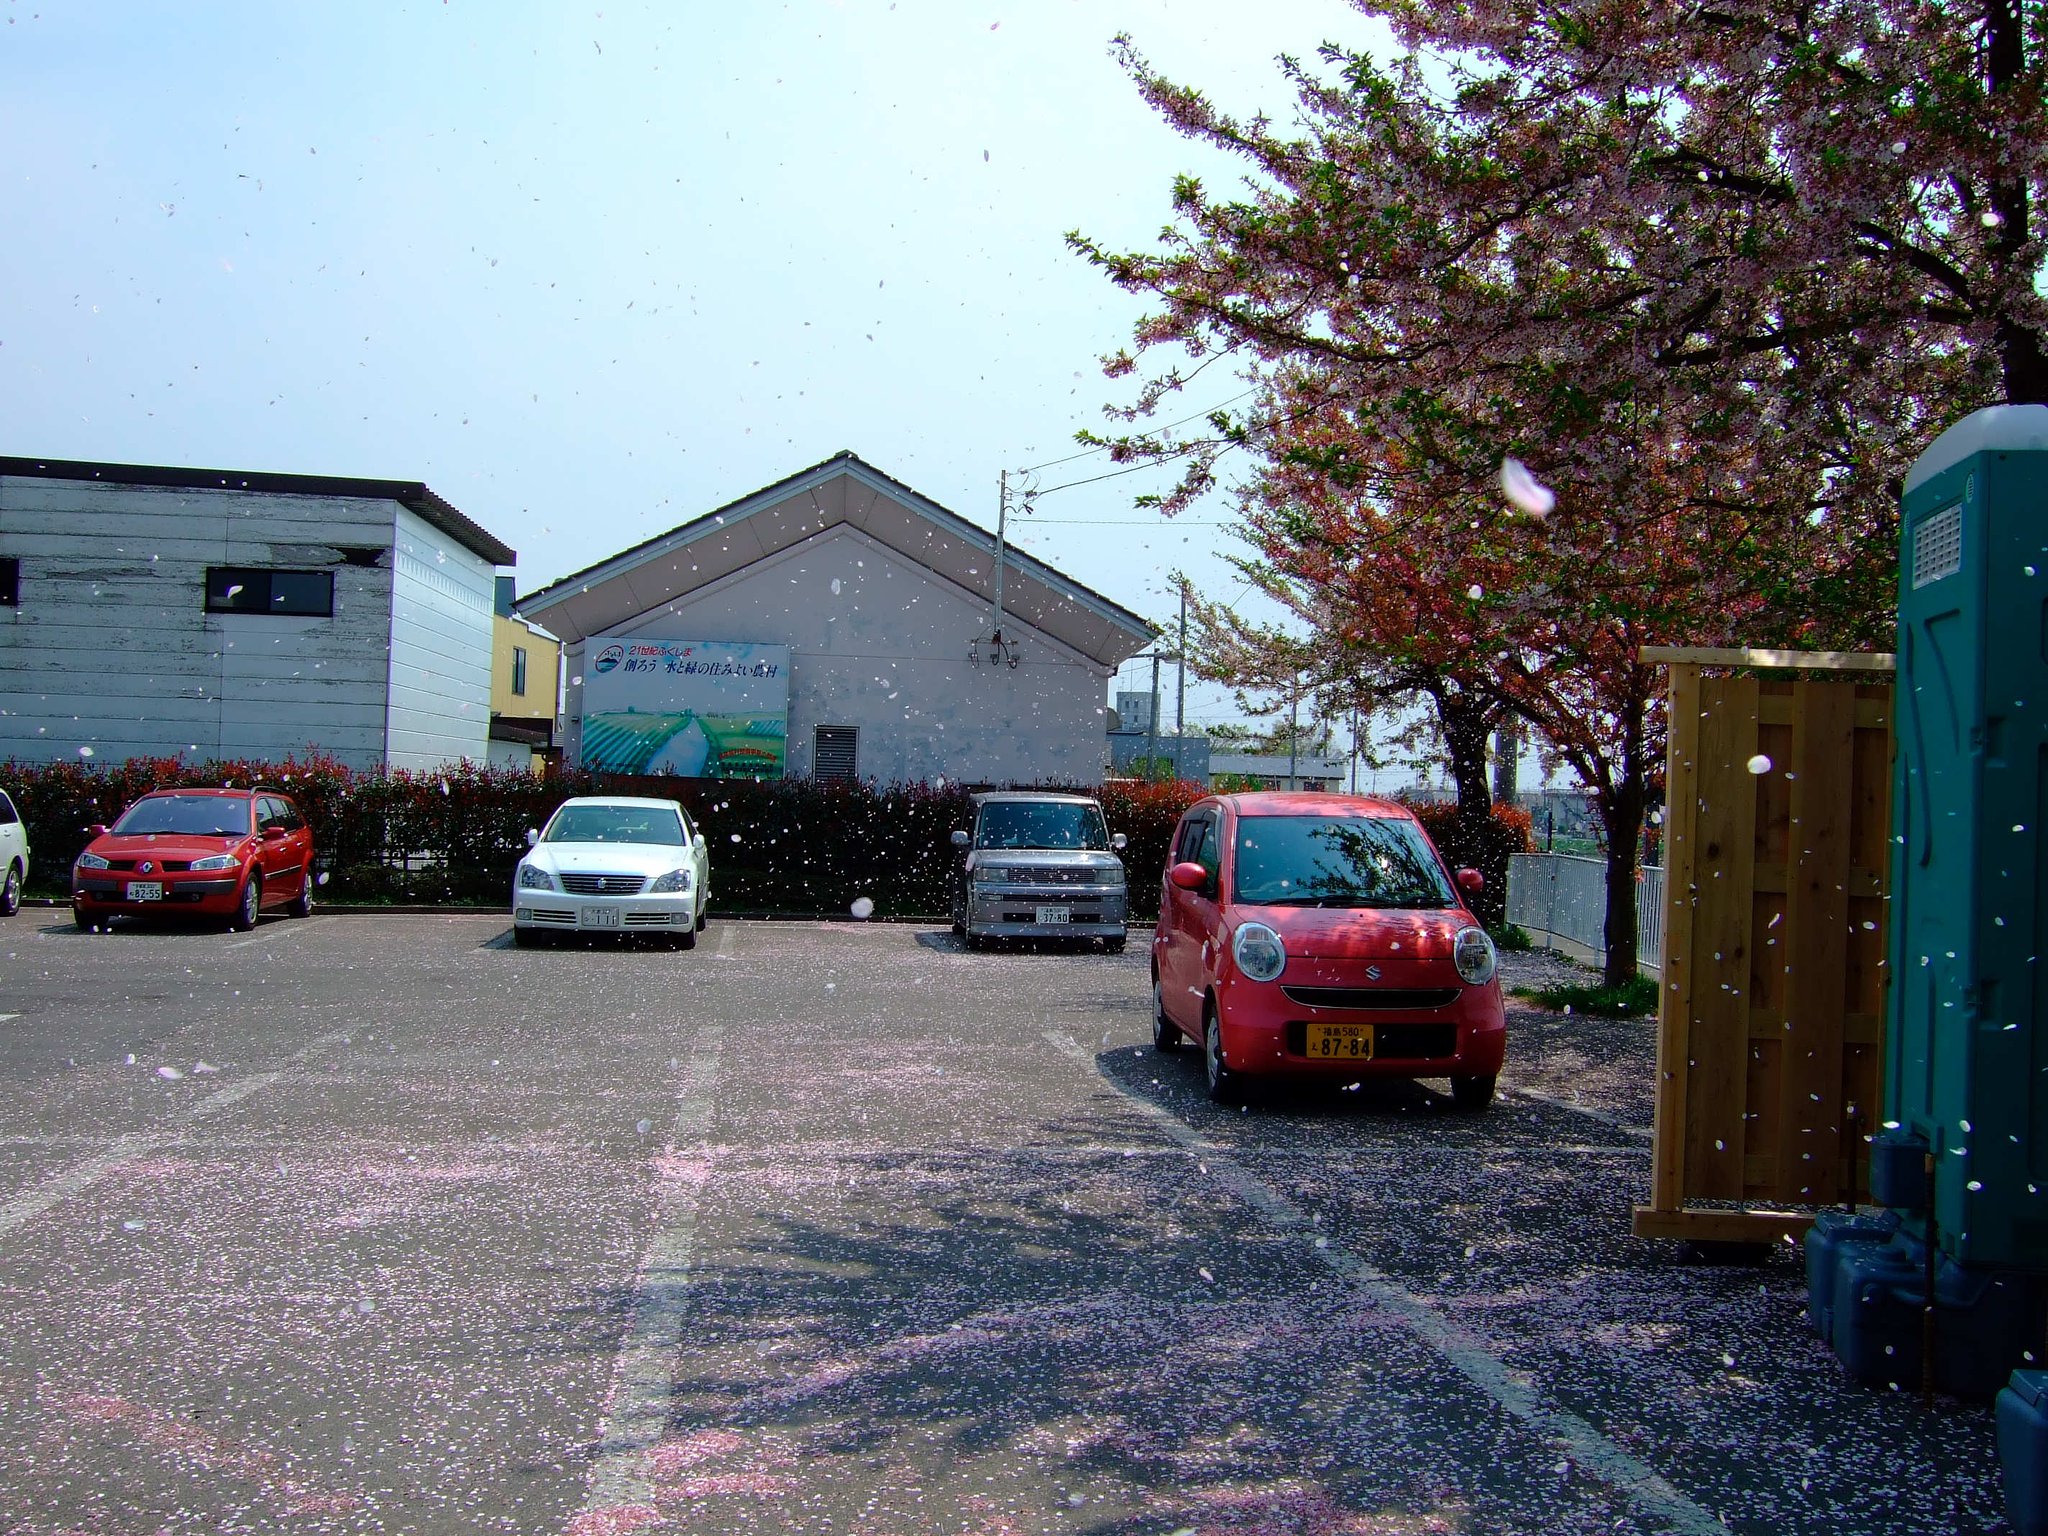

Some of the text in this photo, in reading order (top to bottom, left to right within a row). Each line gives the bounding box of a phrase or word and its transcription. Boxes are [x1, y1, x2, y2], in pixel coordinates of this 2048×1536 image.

[624, 658, 657, 673] 創ろう
[135, 889, 160, 899] 82-55
[1321, 1038, 1370, 1057] 87-84
